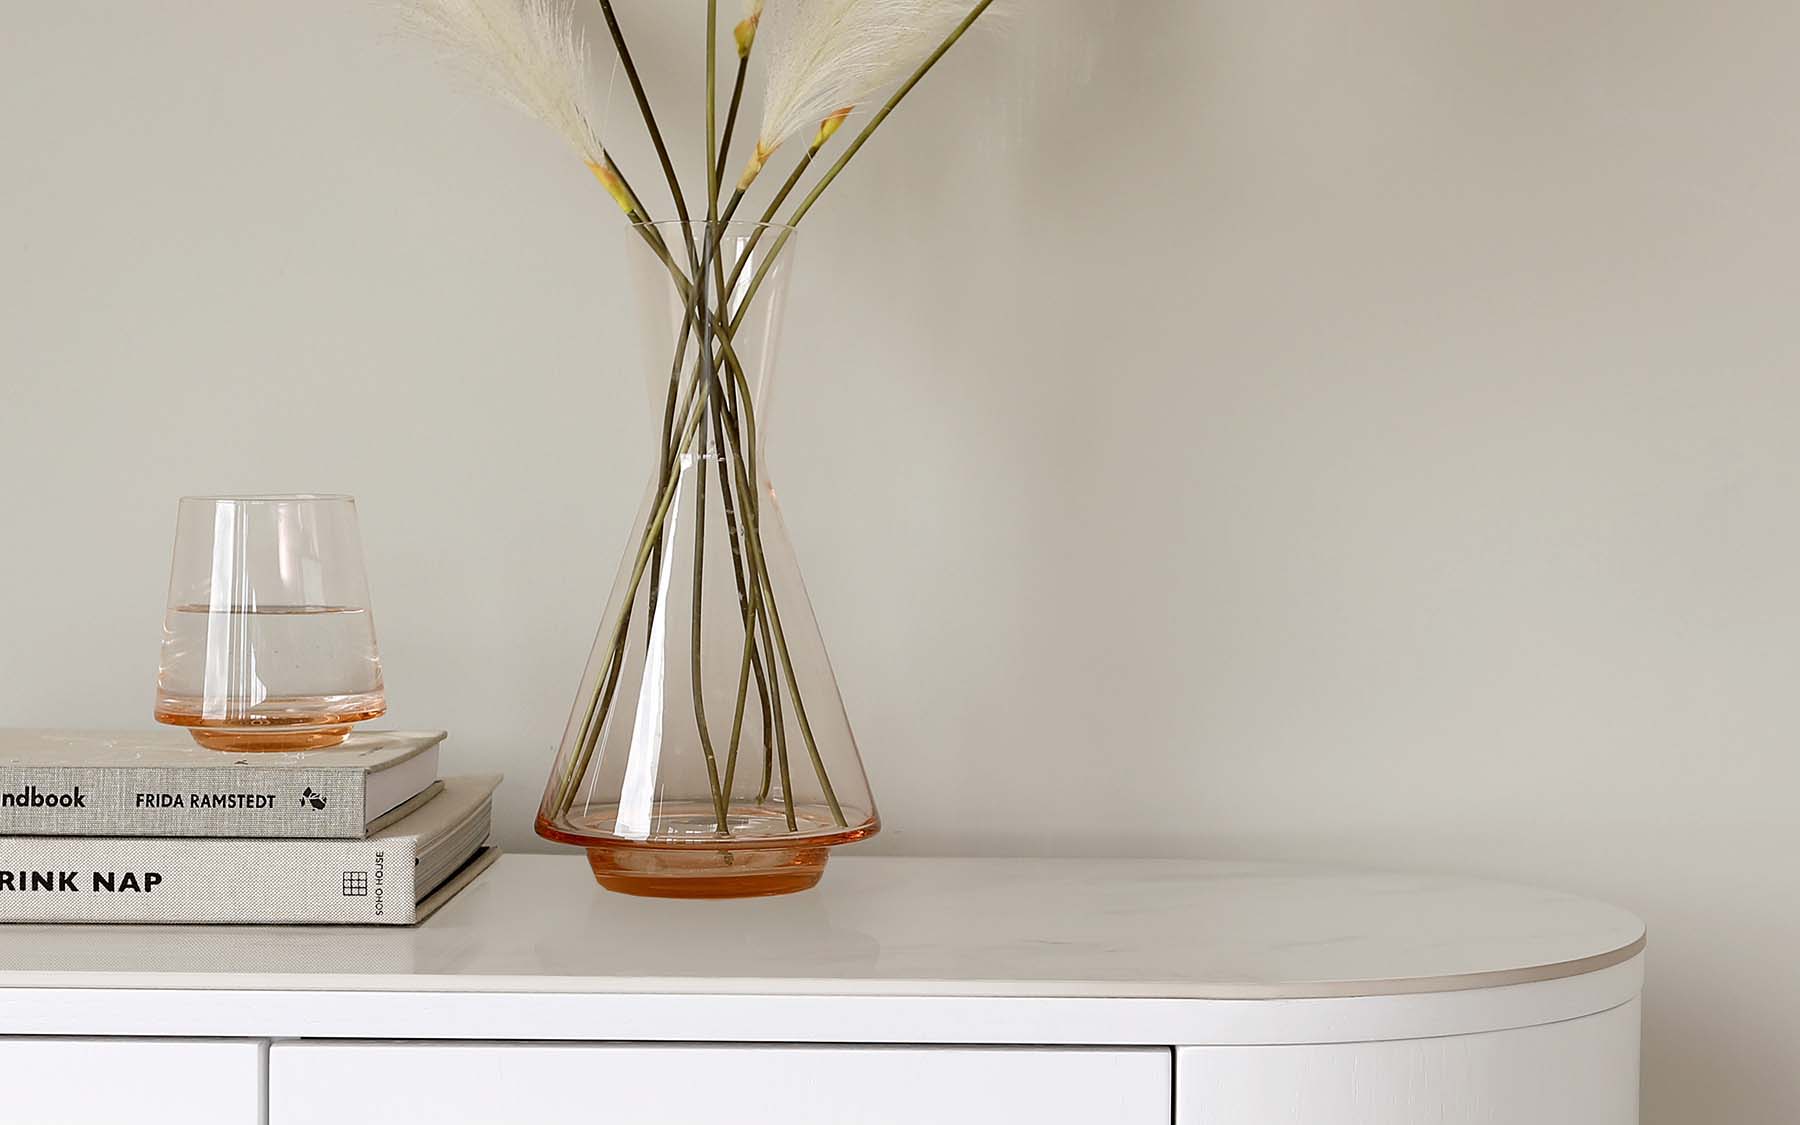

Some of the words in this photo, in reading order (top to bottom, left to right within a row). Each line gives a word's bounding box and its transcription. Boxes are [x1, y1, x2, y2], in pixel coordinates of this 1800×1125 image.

[2, 785, 86, 808] ndbook
[135, 793, 184, 808] FRIDA
[190, 793, 276, 809] RAMSTEDT
[375, 851, 384, 886] HOUSE
[0, 870, 79, 892] RINK
[92, 871, 163, 893] NAP
[375, 888, 384, 916] SOHO
